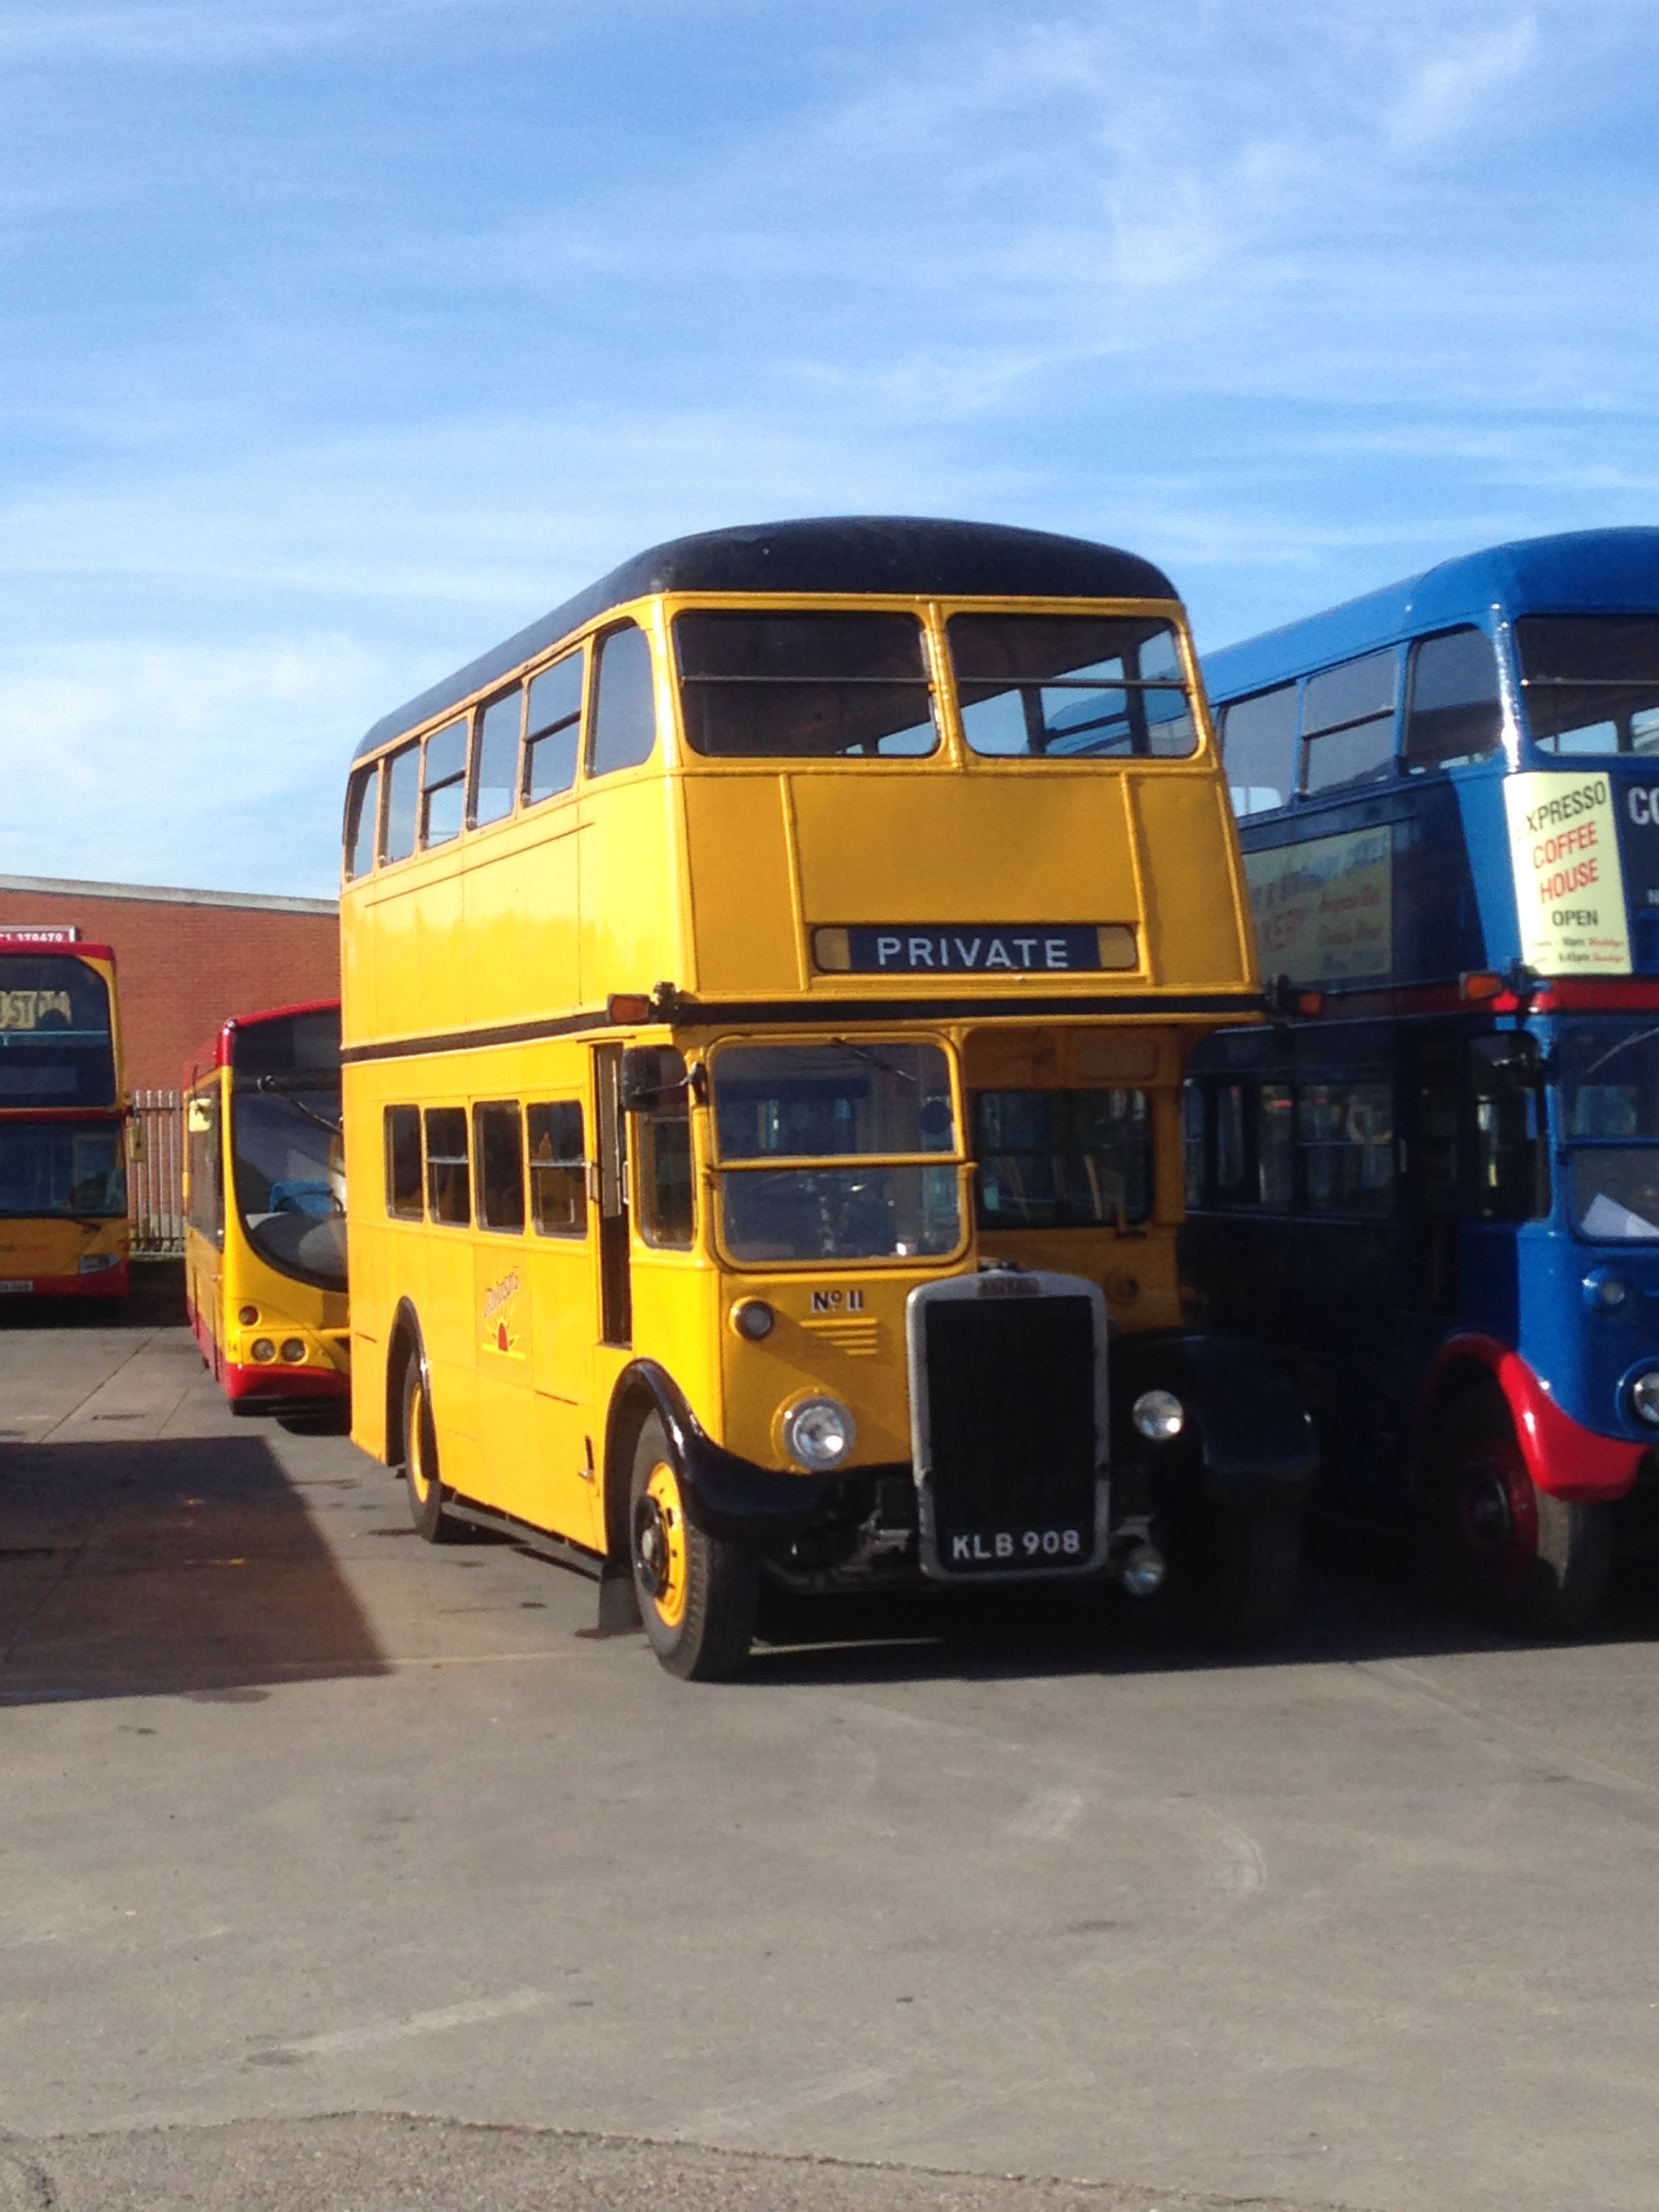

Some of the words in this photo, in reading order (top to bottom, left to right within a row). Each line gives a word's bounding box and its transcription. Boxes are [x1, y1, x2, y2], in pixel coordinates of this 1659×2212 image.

[1517, 781, 1607, 840] XPRESSO
[1533, 821, 1599, 869] COFFEE
[1540, 858, 1599, 904] HOUSE
[1552, 911, 1599, 926] OPEN
[876, 937, 1069, 968] PRIVATE
[953, 1532, 1013, 1559] KLB
[1023, 1530, 1080, 1555] 908
